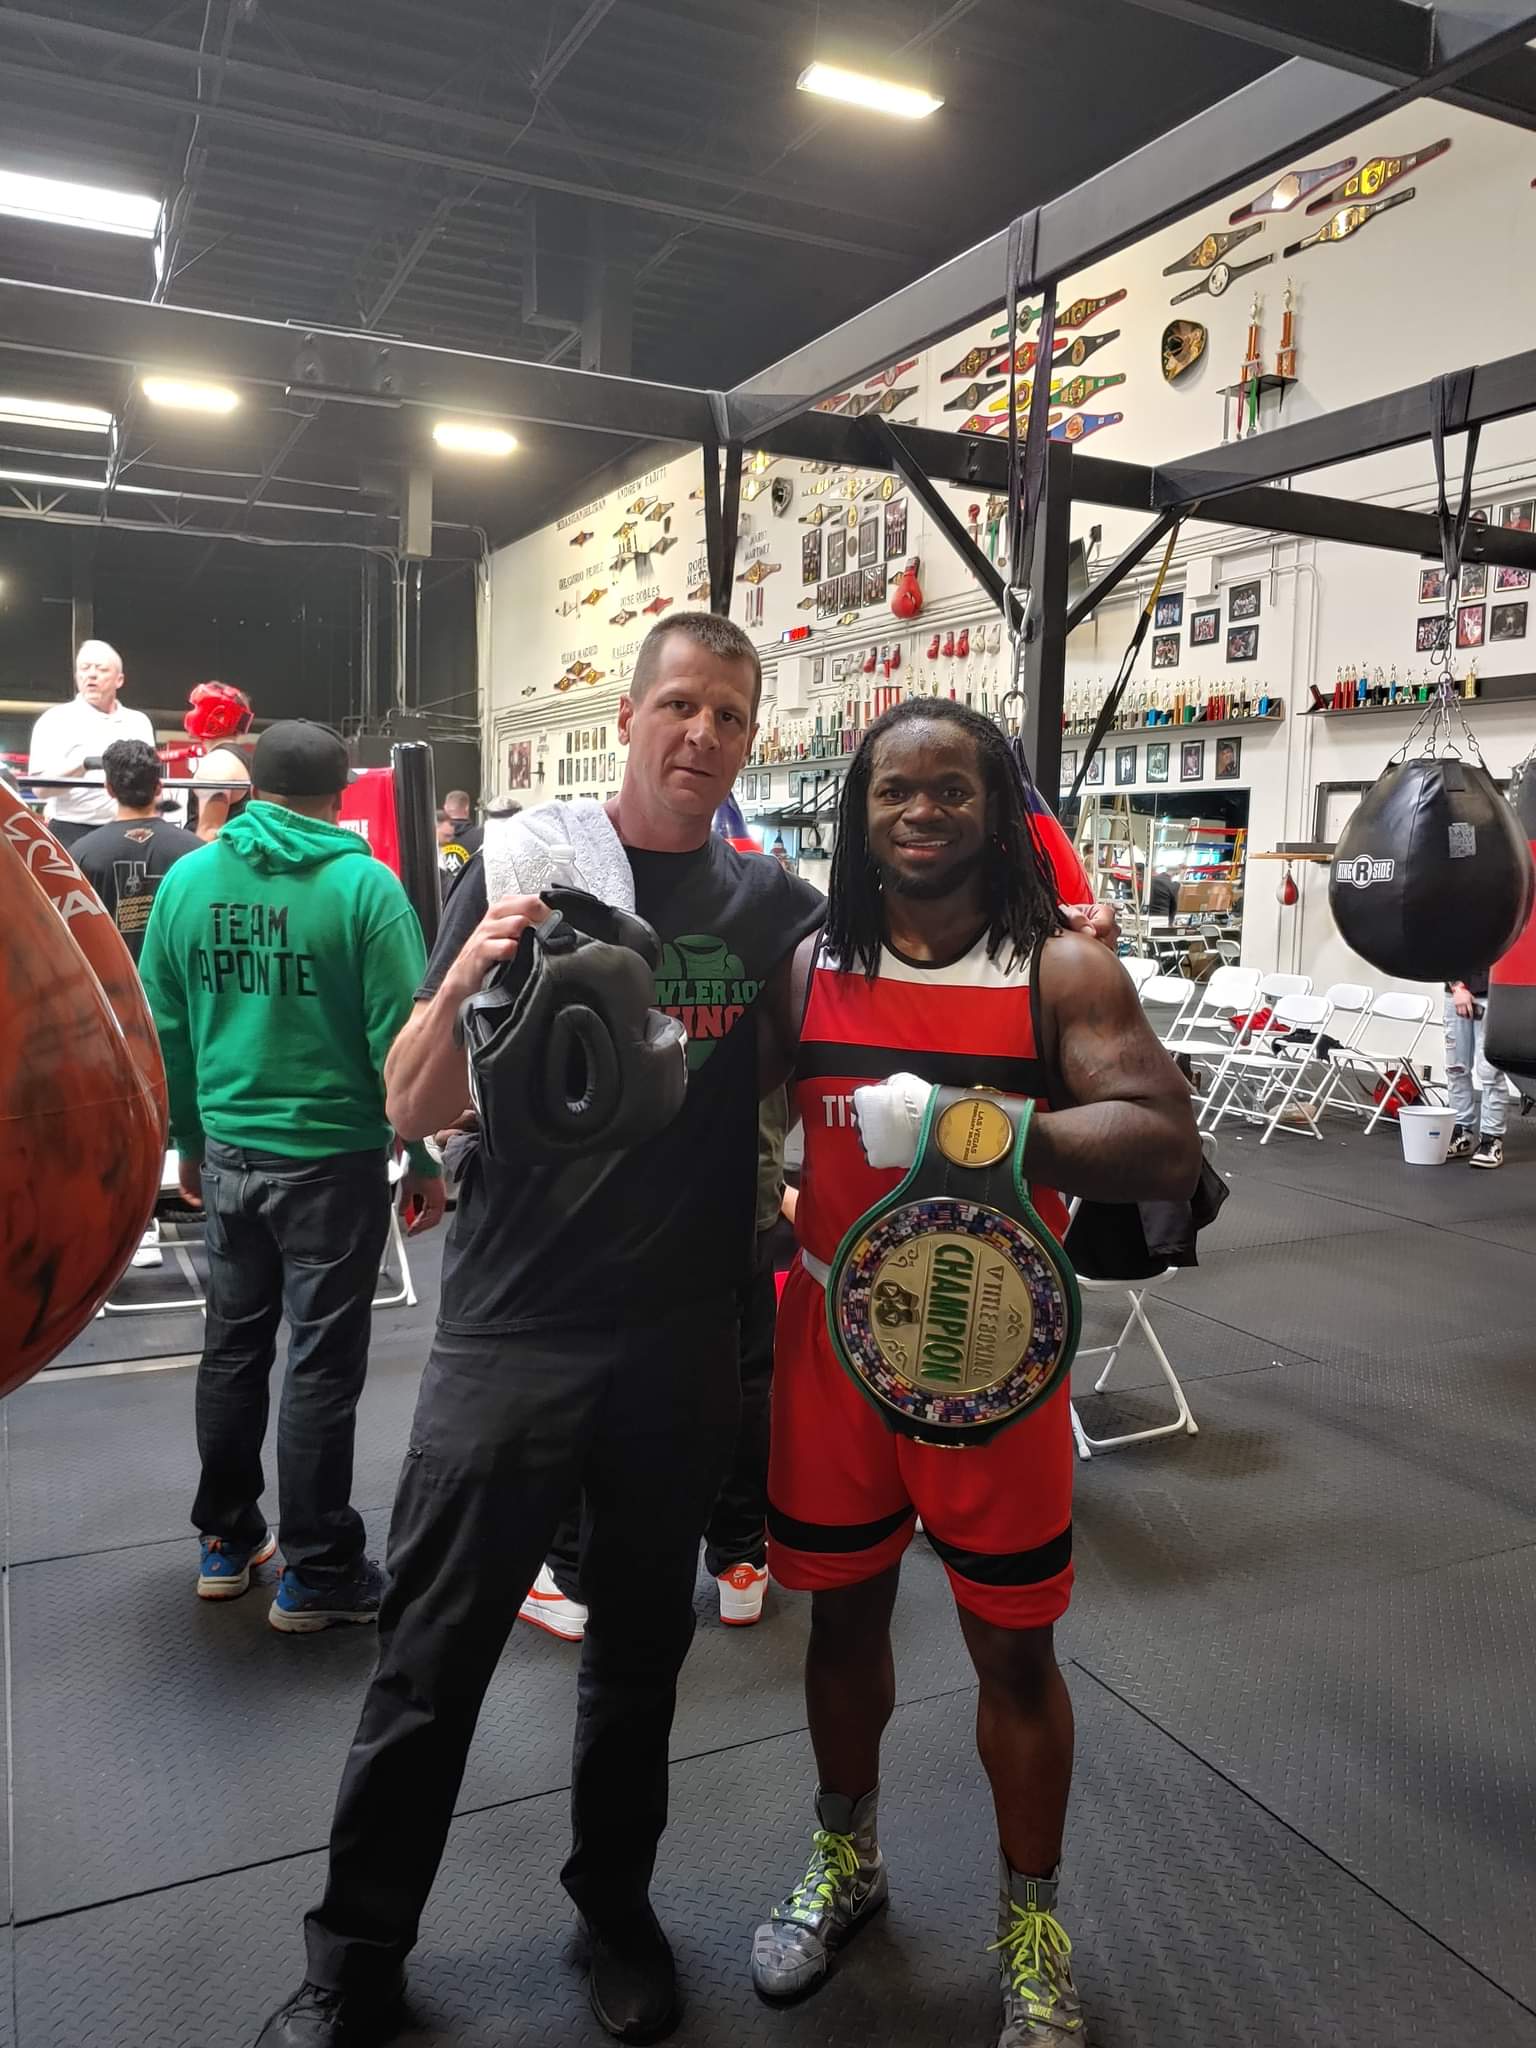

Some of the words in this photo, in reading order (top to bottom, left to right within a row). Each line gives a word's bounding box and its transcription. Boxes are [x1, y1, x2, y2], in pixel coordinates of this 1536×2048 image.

[1373, 862, 1391, 879] SIDE
[209, 903, 288, 948] TEAM
[198, 949, 317, 996] APONTE
[731, 980, 766, 1004] 10
[976, 1110, 984, 1126] LAS
[970, 1128, 982, 1154] VEGAS
[921, 1244, 974, 1383] CHAMPION
[980, 1282, 1002, 1322] TITLE
[973, 1323, 997, 1378] BOXING
